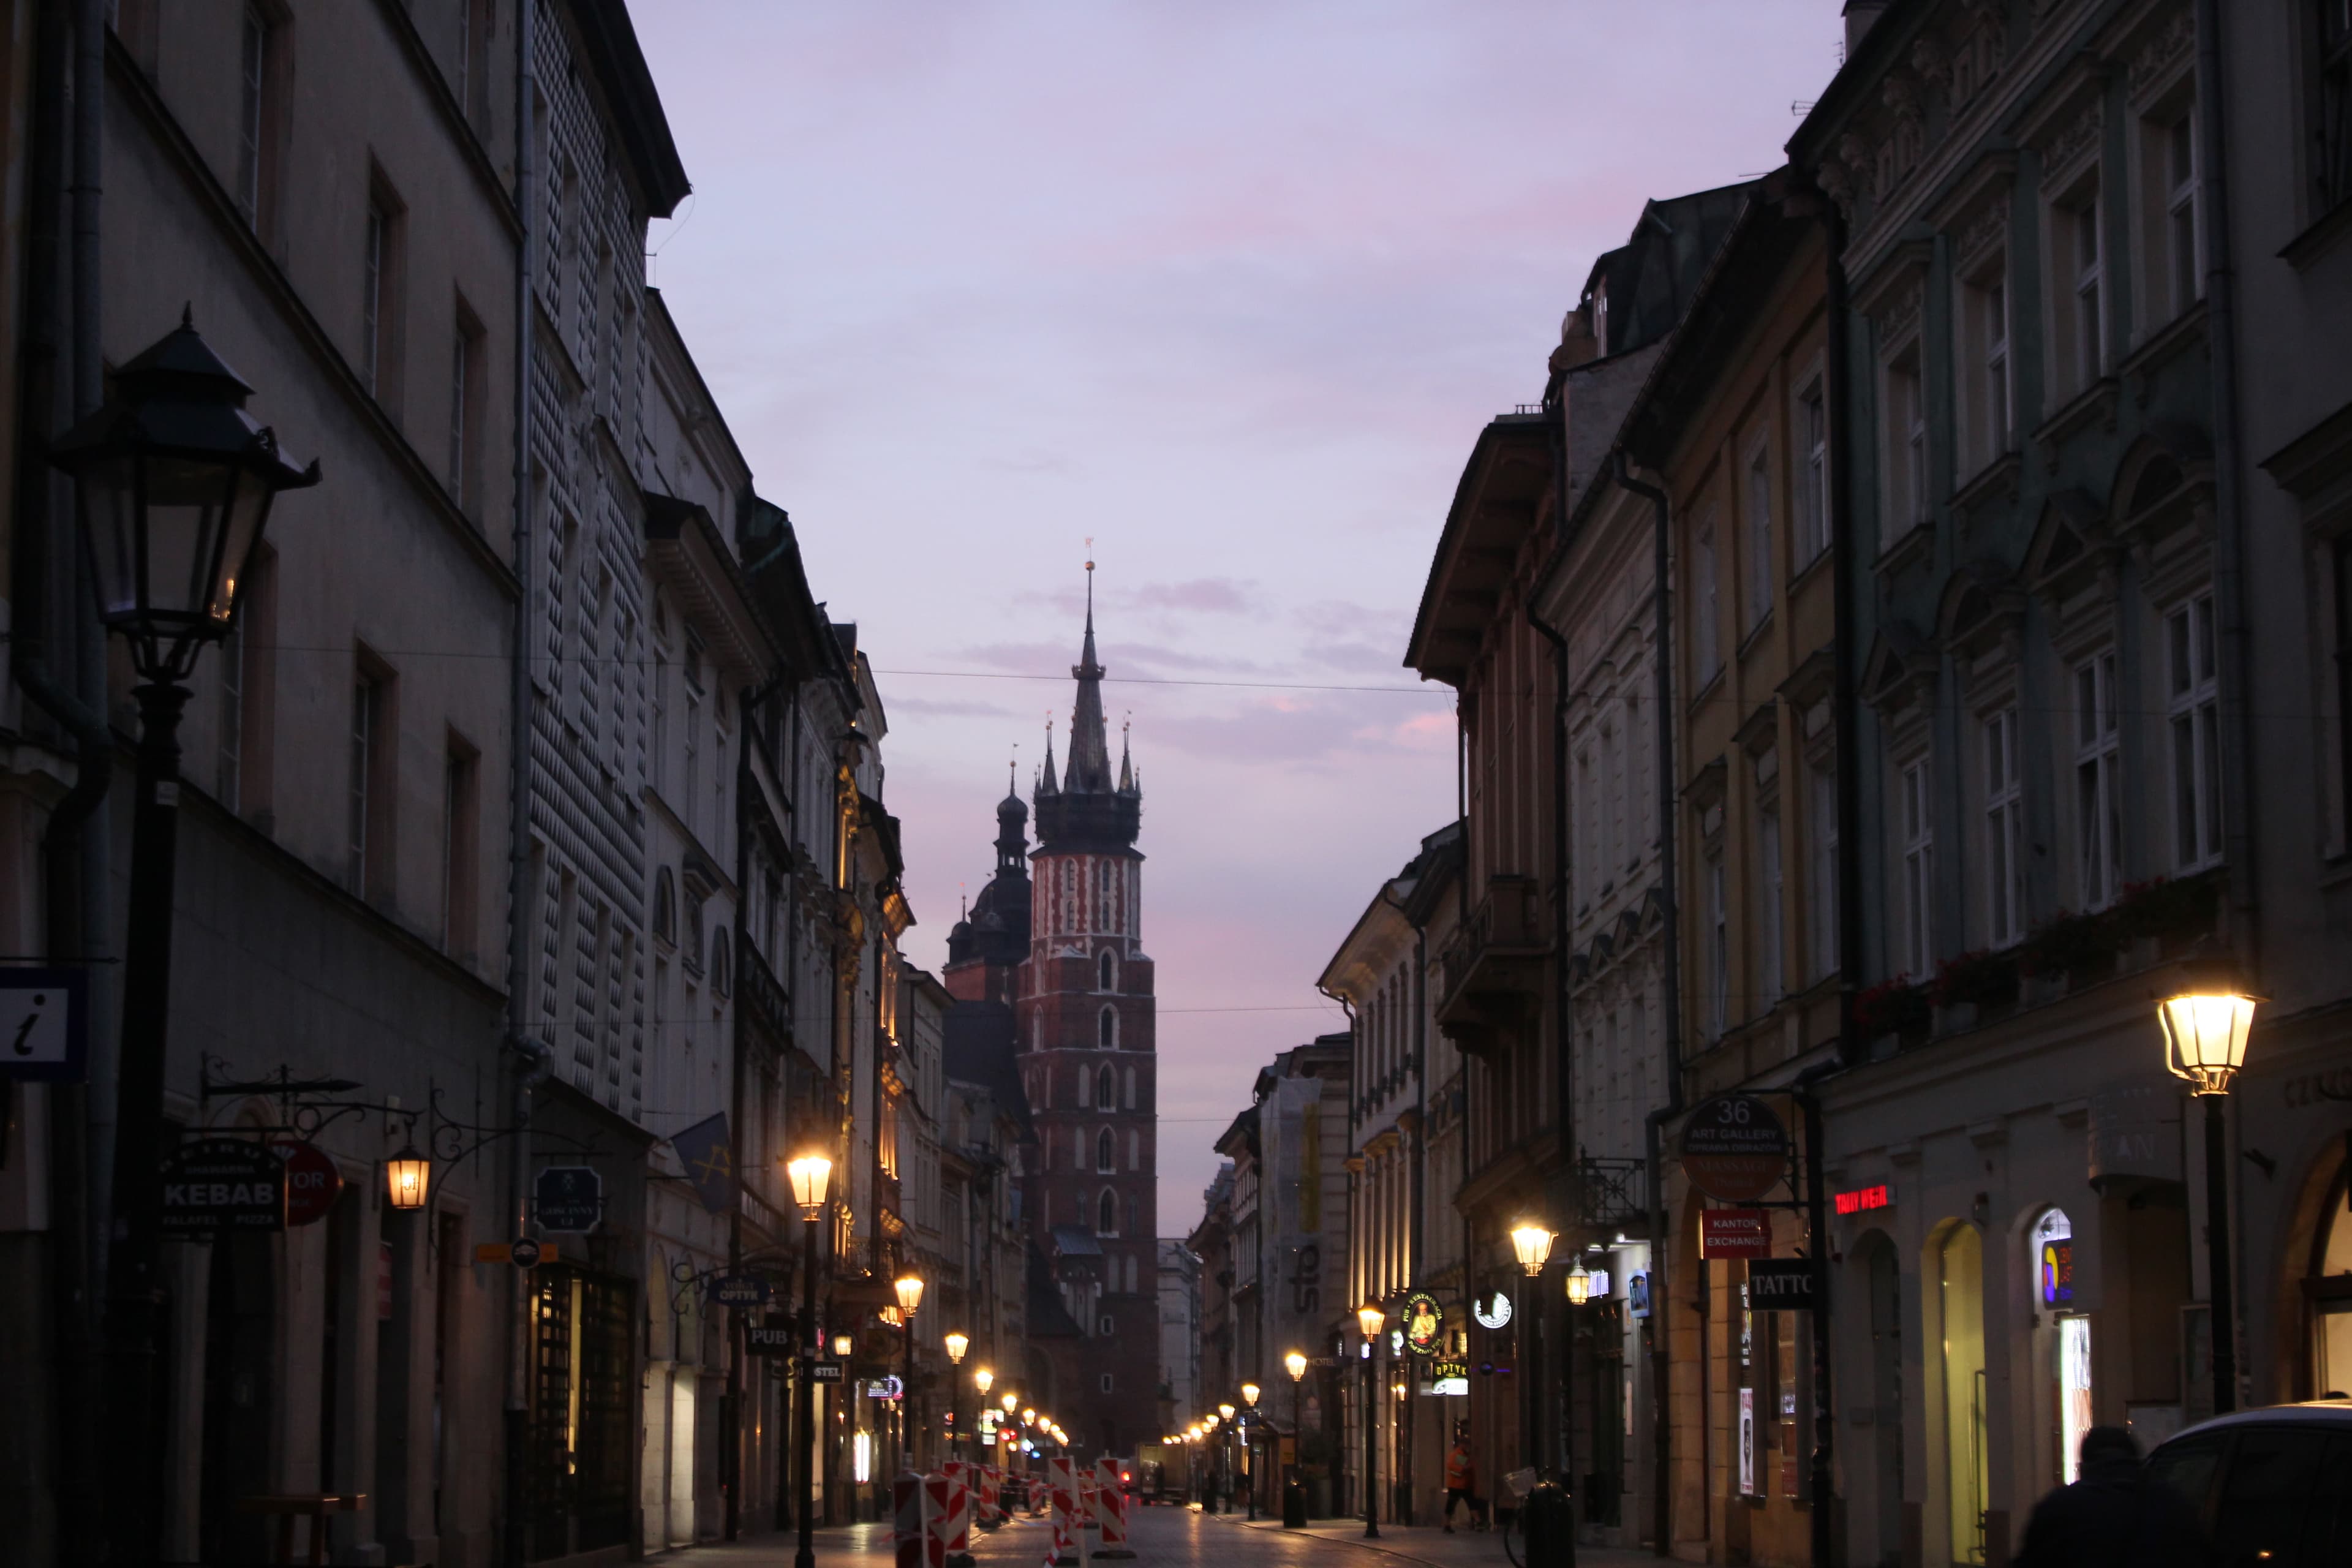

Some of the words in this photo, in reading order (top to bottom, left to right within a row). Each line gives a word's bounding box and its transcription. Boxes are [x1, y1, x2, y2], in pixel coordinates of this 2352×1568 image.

[1717, 1100, 1750, 1124] 36
[1691, 1128, 1715, 1139] ART
[1719, 1128, 1778, 1139] GALLERY
[164, 1182, 274, 1206] KEBAB
[162, 1215, 219, 1226] FALAFEL
[235, 1213, 274, 1224] PIZZA
[1713, 1219, 1758, 1229] KANTOR
[1706, 1236, 1766, 1246] EXCHANGE
[719, 1289, 758, 1301] OPTYK
[752, 1329, 788, 1345] PUB
[1308, 1358, 1333, 1366] HOTEL
[1436, 1364, 1467, 1375] OPTYK
